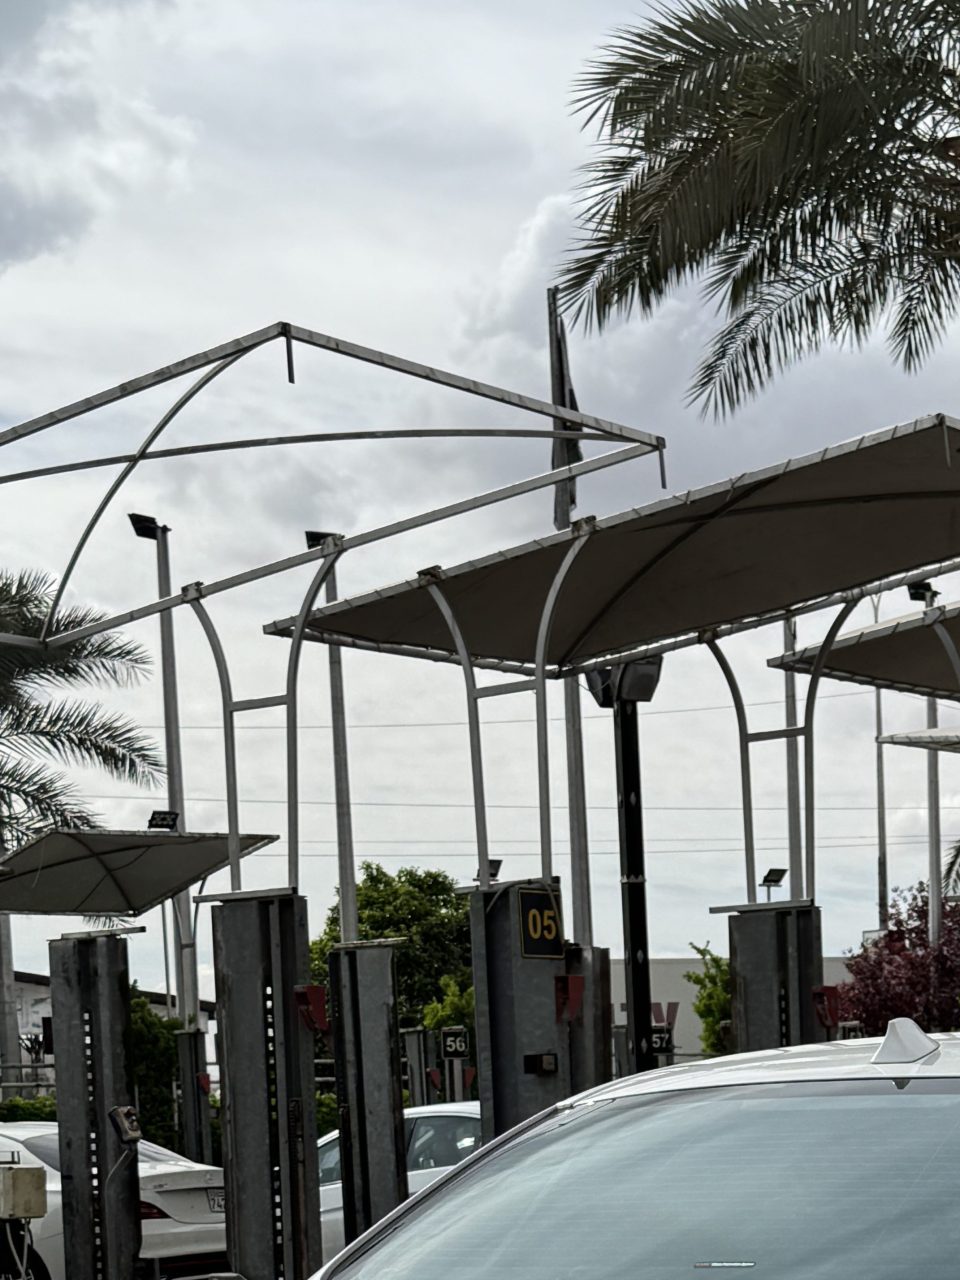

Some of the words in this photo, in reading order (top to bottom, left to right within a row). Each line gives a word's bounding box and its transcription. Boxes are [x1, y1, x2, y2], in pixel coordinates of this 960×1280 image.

[528, 909, 557, 940] 05
[446, 1037, 465, 1052] 56
[652, 1034, 669, 1048] 57
